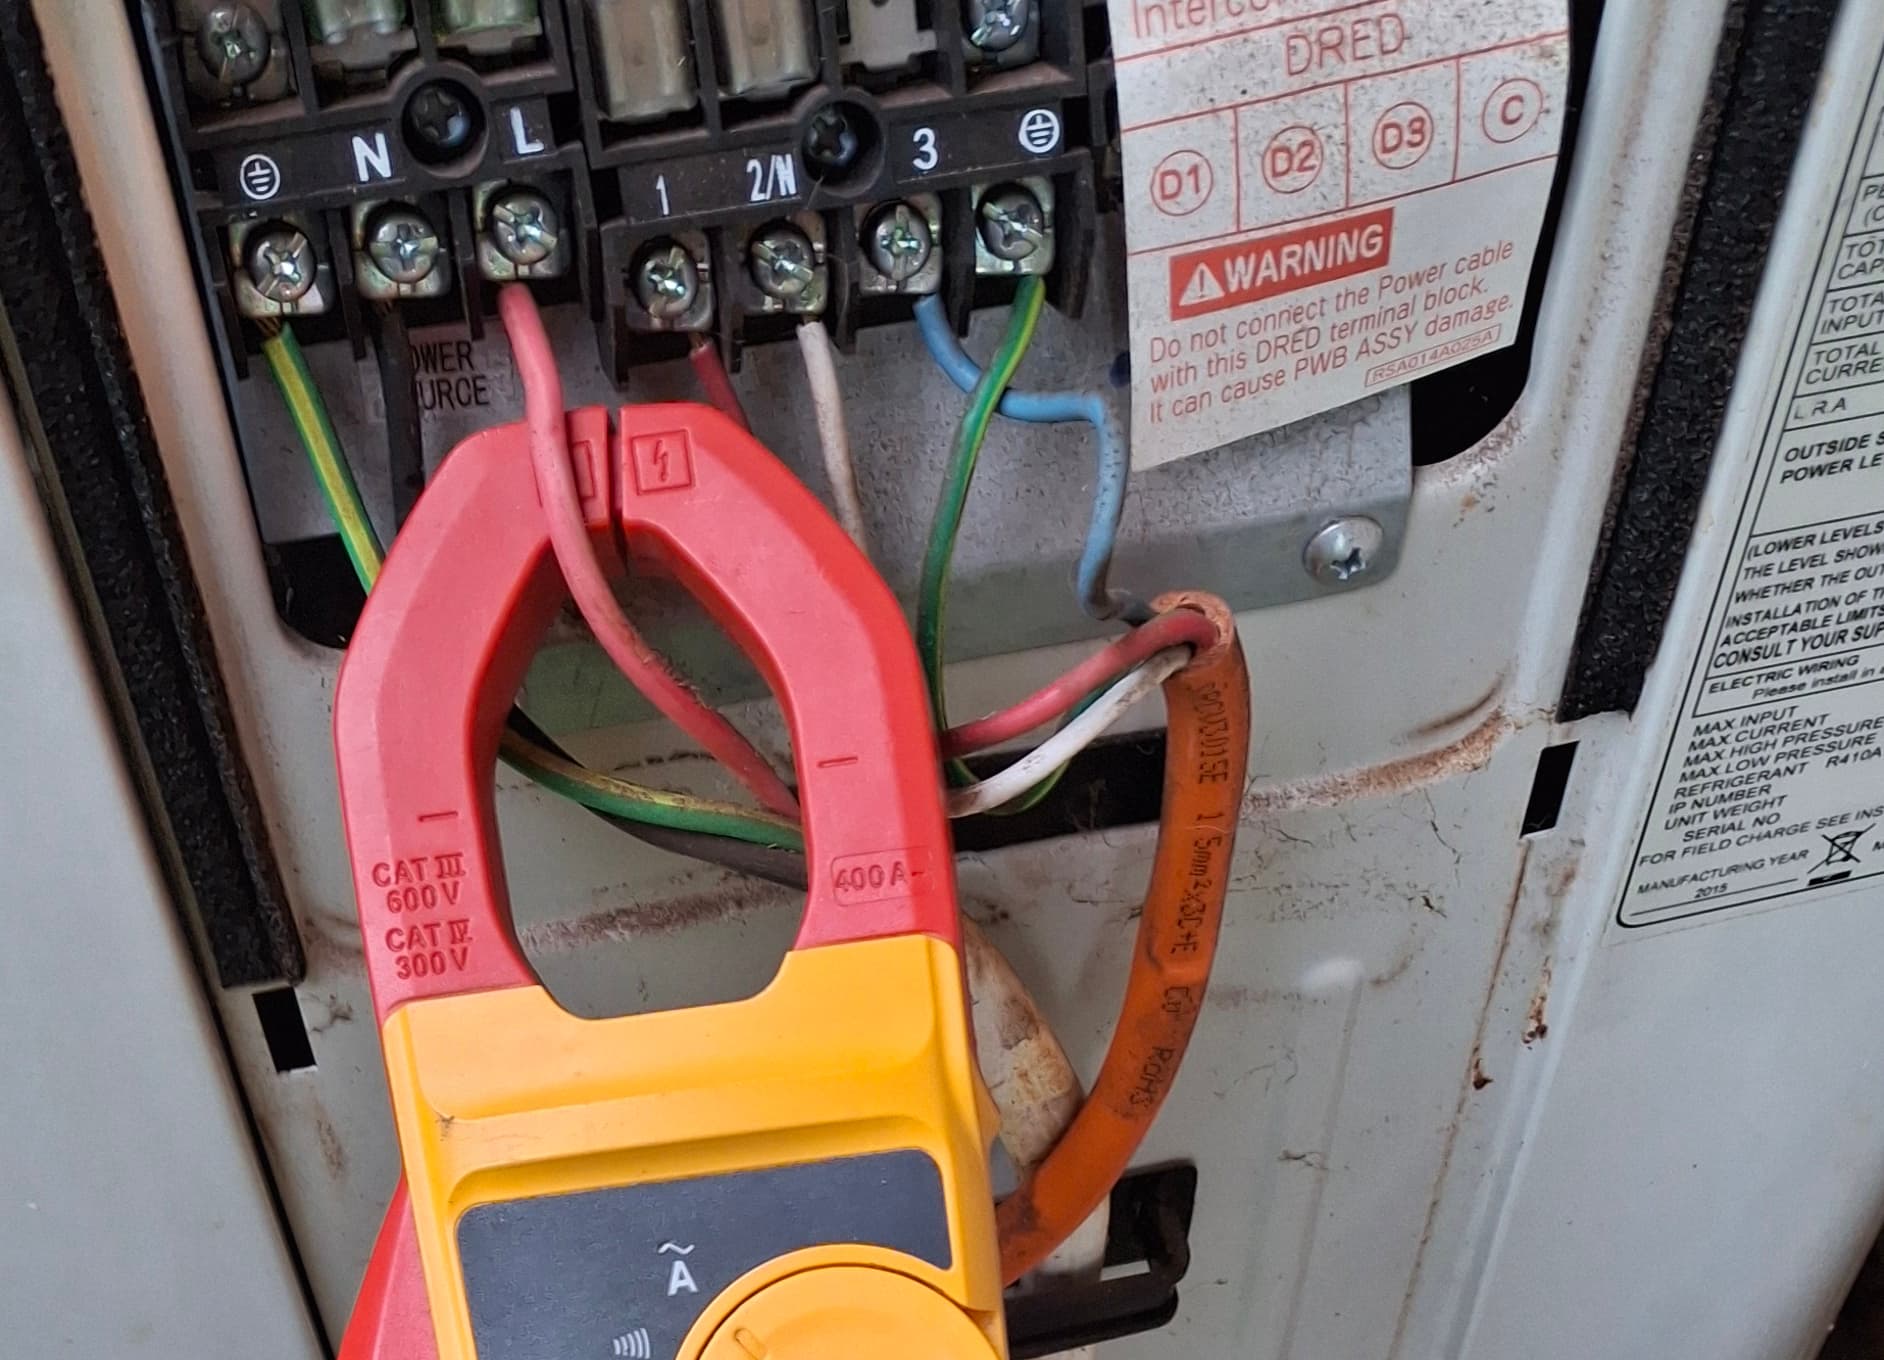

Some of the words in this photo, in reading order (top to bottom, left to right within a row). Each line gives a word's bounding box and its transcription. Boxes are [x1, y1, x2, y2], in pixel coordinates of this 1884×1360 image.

[1287, 13, 1404, 77] DRED
[1501, 95, 1523, 125] C
[510, 107, 544, 154] L
[912, 128, 938, 170] 3
[1380, 116, 1425, 154] D3
[352, 133, 391, 182] N
[1271, 140, 1316, 178] D2
[656, 175, 669, 216] 1
[747, 154, 797, 200] 2/N
[1160, 164, 1202, 201] D1
[1224, 224, 1383, 294] WARNING
[1151, 337, 1181, 362] Do
[1190, 326, 1226, 350] not
[1236, 300, 1326, 339] connect
[1336, 284, 1369, 312] the
[1378, 263, 1447, 299] Power
[1454, 240, 1513, 275] cable
[1151, 365, 1204, 393] with
[1208, 348, 1247, 377] this
[1257, 325, 1321, 363] DRED
[1331, 295, 1416, 340] terminal
[1424, 277, 1488, 312] block.
[1815, 341, 1881, 365] TOTAL
[1151, 403, 1162, 424] It
[1172, 391, 1212, 417] can
[1221, 370, 1285, 403] cause
[1294, 348, 1347, 381] PWB
[1356, 322, 1418, 361] ASSY
[1424, 295, 1513, 337] damage.
[1785, 434, 1872, 462] OUTSIDE
[1780, 459, 1854, 484] POWER
[1747, 534, 1816, 561] (LOWER
[1820, 521, 1884, 544] LEVELS
[1744, 563, 1774, 580] THE
[1778, 553, 1828, 573] LEVEL
[1735, 578, 1814, 604] WHETHER
[1820, 570, 1851, 587] THE
[1725, 595, 1841, 628] INSTALLATION
[1845, 590, 1868, 606] OF
[1714, 639, 1797, 668] CONSULT
[1801, 629, 1849, 652] YOUR
[1720, 615, 1833, 648] ACCEPTABLE
[1709, 668, 1793, 693] ELECTRIC
[1799, 655, 1859, 676] WIRING
[1752, 682, 1806, 699] Please
[1812, 669, 1857, 688] install
[1861, 667, 1875, 678] in
[1735, 713, 1830, 742] CURRENT
[1741, 705, 1799, 727] INPUT
[1725, 755, 1770, 773] LOW
[1774, 732, 1877, 764] PRESSURE
[1730, 737, 1777, 758] HIGH
[1782, 716, 1884, 747] PRESSURE
[1674, 762, 1810, 799] REFRIGERANT
[1825, 747, 1881, 768] R410A
[1664, 811, 1707, 830] UNIT
[1712, 795, 1788, 820] WEIGHT
[1668, 802, 1686, 814] IP
[1691, 784, 1772, 810] NUMBER
[1639, 850, 1676, 866] FOR
[1681, 838, 1732, 858] FIELD
[1736, 822, 1811, 847] CHARGE
[1816, 813, 1851, 830] SEE
[1683, 825, 1745, 842] SERIAL
[1752, 812, 1781, 827] NO
[372, 857, 428, 887] CAT
[1637, 859, 1765, 894] MANUFACTURING
[1770, 850, 1810, 867] YEAR
[386, 923, 441, 952] CAT
